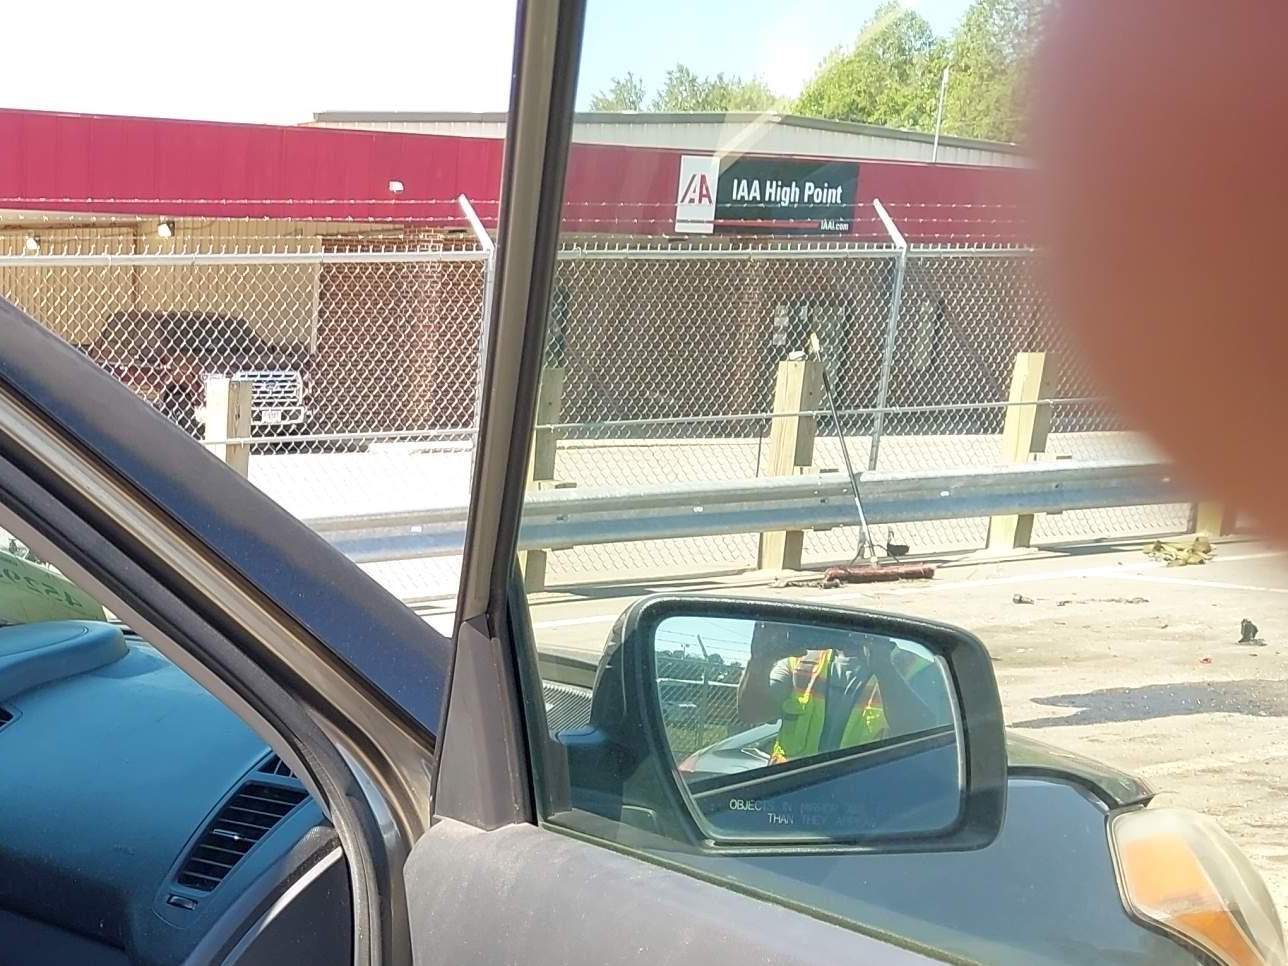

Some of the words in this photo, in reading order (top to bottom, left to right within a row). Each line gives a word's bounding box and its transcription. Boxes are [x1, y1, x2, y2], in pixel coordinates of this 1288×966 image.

[732, 179, 761, 201] IAA
[765, 180, 800, 207] High
[805, 182, 842, 204] Point
[767, 812, 794, 825] THAN
